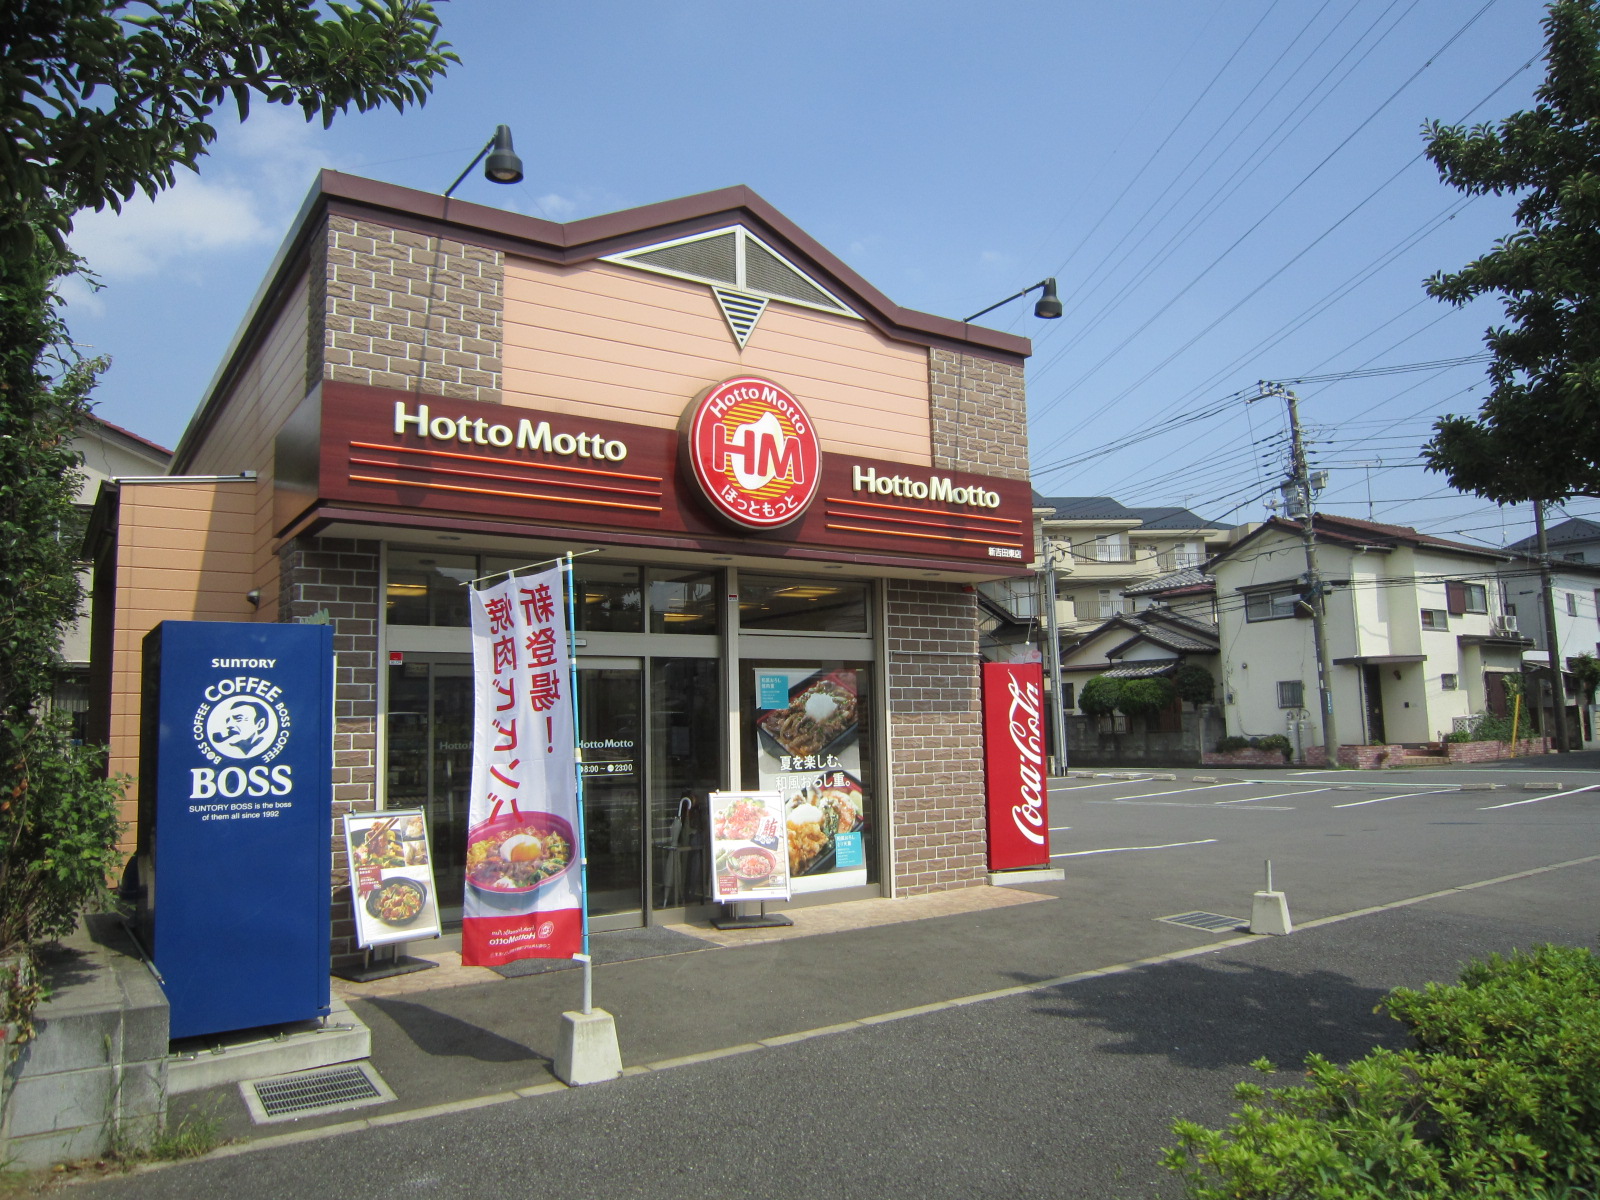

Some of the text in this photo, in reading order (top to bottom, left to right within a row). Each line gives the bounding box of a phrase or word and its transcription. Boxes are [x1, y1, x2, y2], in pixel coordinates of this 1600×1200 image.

[713, 422, 805, 485] HM
[720, 484, 798, 518] ほっともっと
[211, 658, 277, 669] SUNTORY
[204, 676, 283, 703] COFFEE
[193, 702, 222, 765] BOSS COFFEE
[261, 702, 291, 764] BOSS COFFEE
[584, 765, 599, 773] 8:00
[614, 764, 633, 772] 23:00
[780, 754, 842, 771] 夏を楽しむ、
[1008, 668, 1044, 844] Coca-Cola
[189, 764, 293, 799] BOSS
[775, 772, 851, 791] 和風おろし重。
[189, 804, 229, 813] SUNTORY
[230, 802, 253, 811] BOSS
[202, 813, 209, 821] of
[241, 811, 260, 819] since
